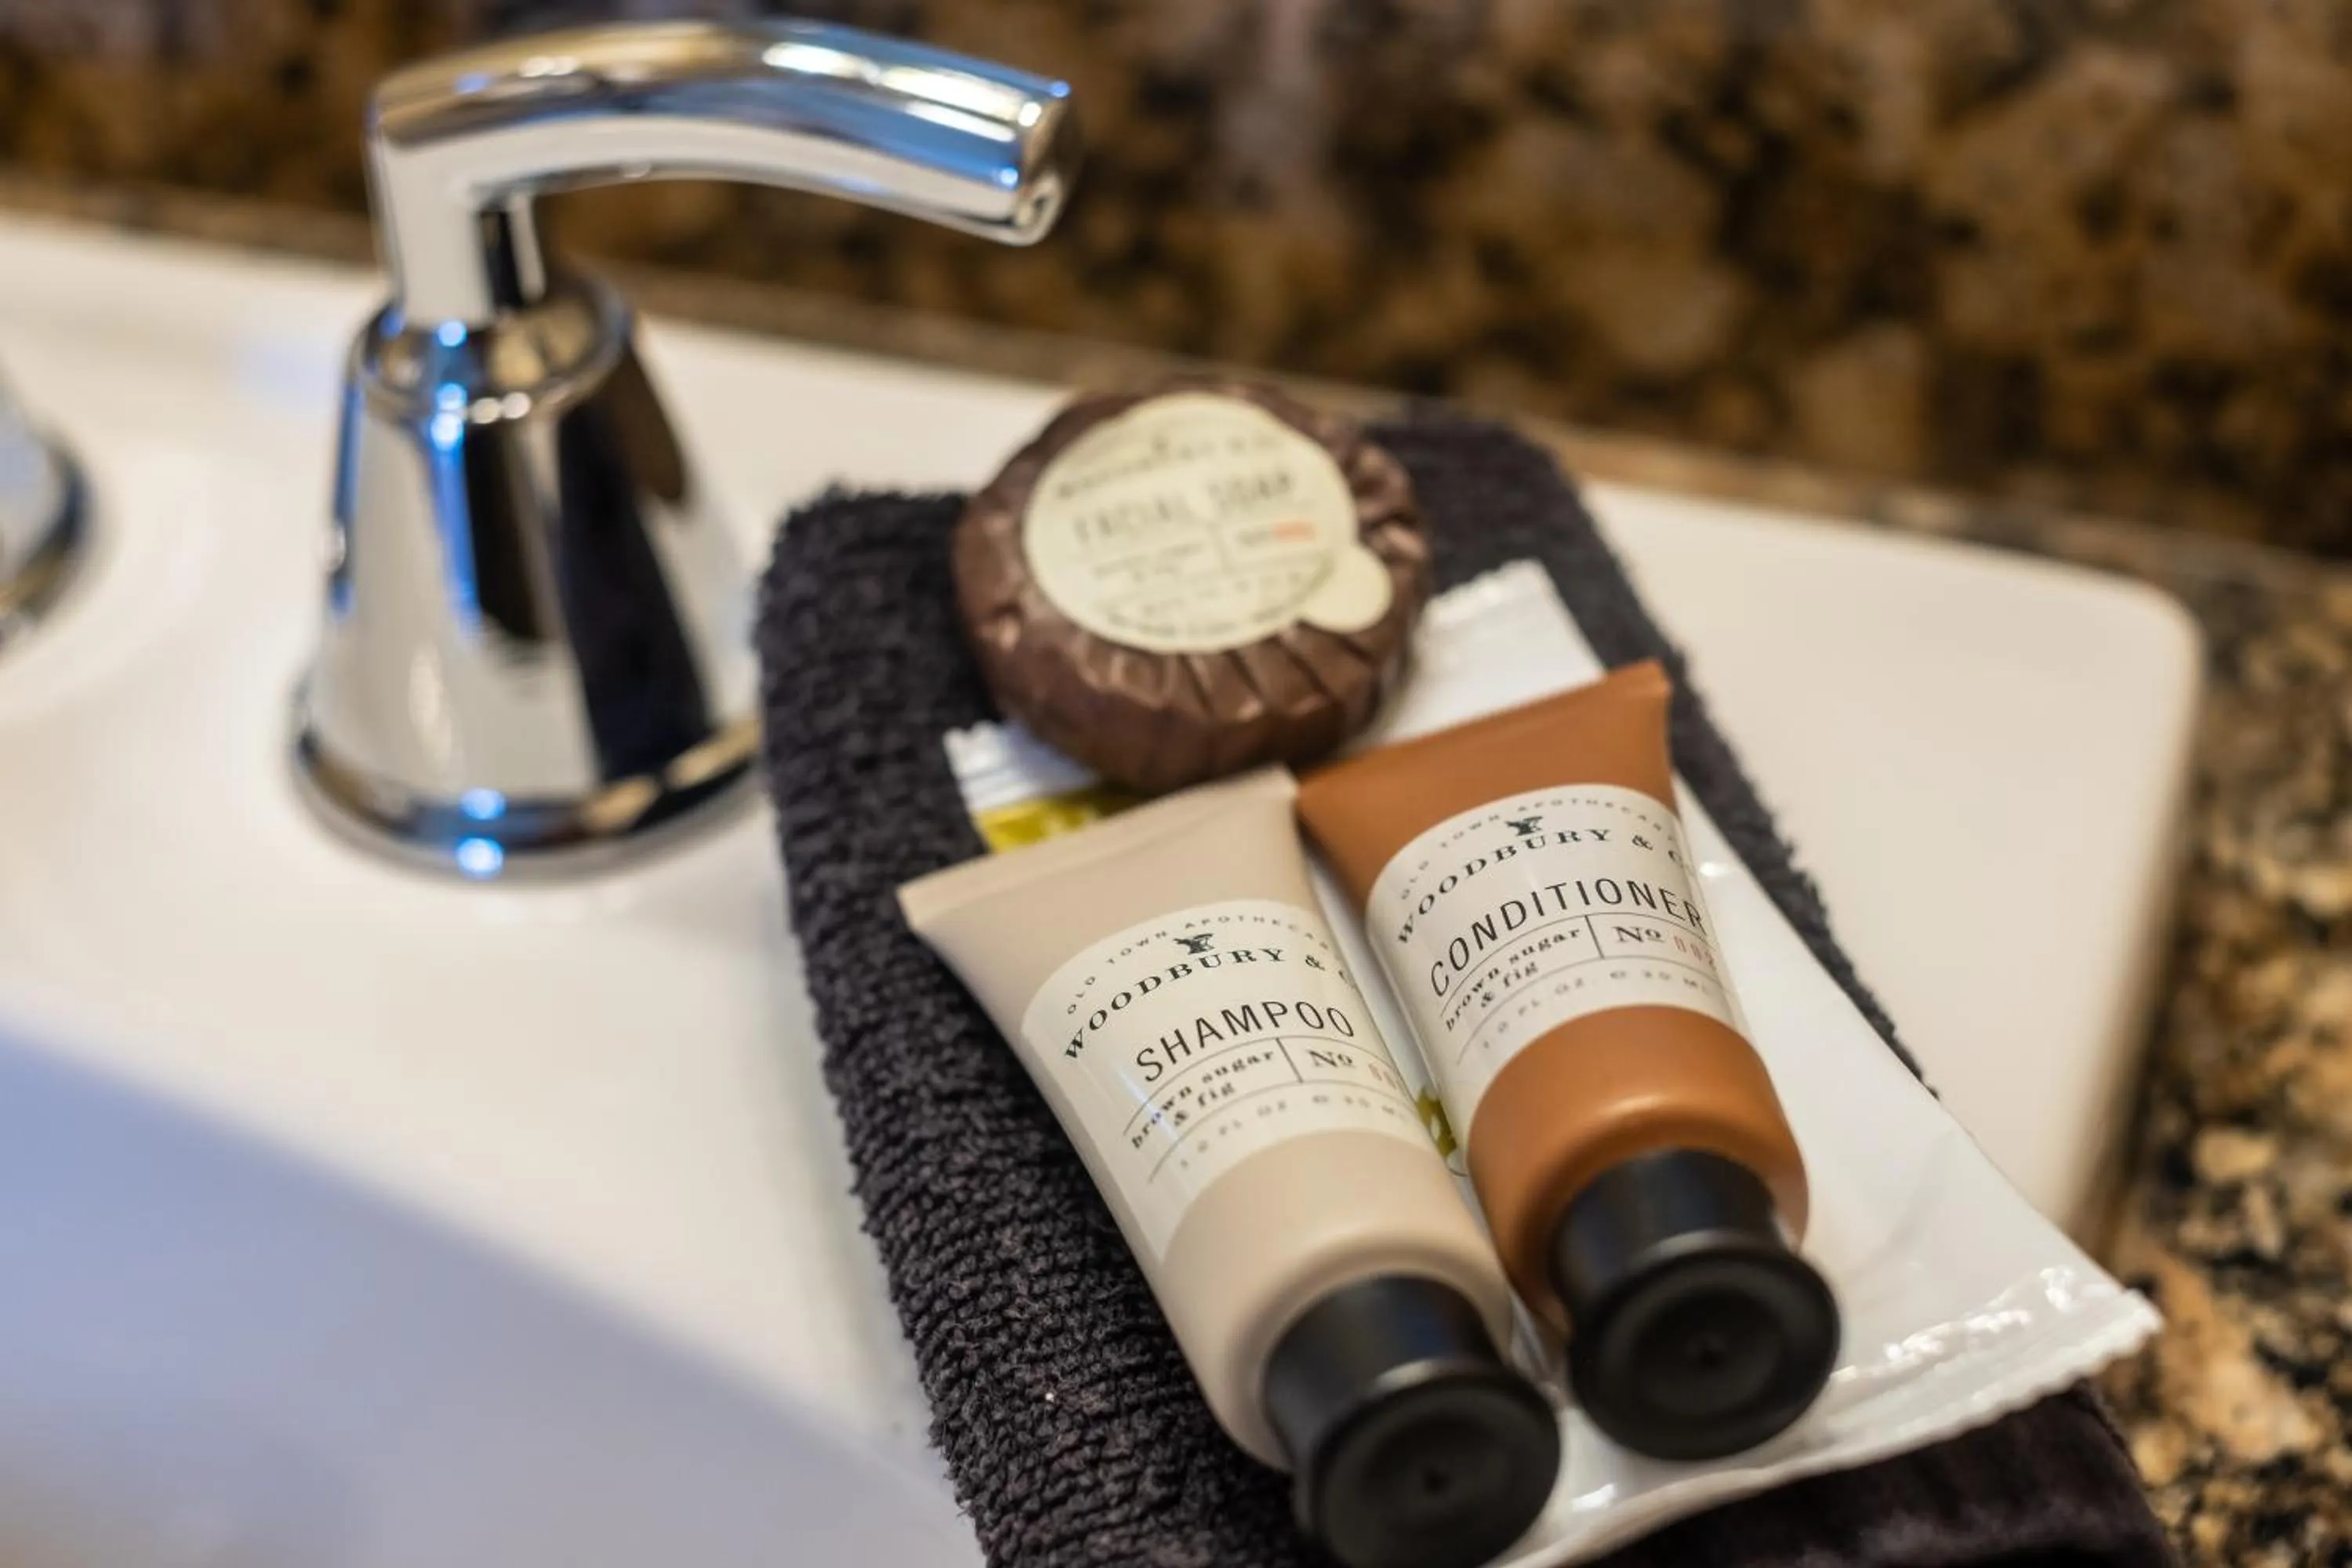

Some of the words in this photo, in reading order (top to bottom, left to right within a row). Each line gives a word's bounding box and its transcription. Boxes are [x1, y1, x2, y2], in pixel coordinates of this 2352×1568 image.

[1398, 829, 1612, 944] WOODBURY
[1632, 834, 1653, 851] &
[1067, 976, 1096, 1014] OLD
[1106, 931, 1167, 965] TOWN
[1431, 878, 1708, 997] CONDITIONER
[1446, 967, 1500, 1033] brown
[1508, 928, 1581, 965] sugar
[1503, 961, 1539, 989] fig
[1064, 948, 1287, 1061] WOODBURY
[1305, 954, 1326, 971] &
[1136, 1000, 1355, 1083] SHAMPOO
[1131, 1086, 1192, 1149] brown
[1202, 1051, 1273, 1083] sugar
[1197, 1082, 1236, 1108] fig
